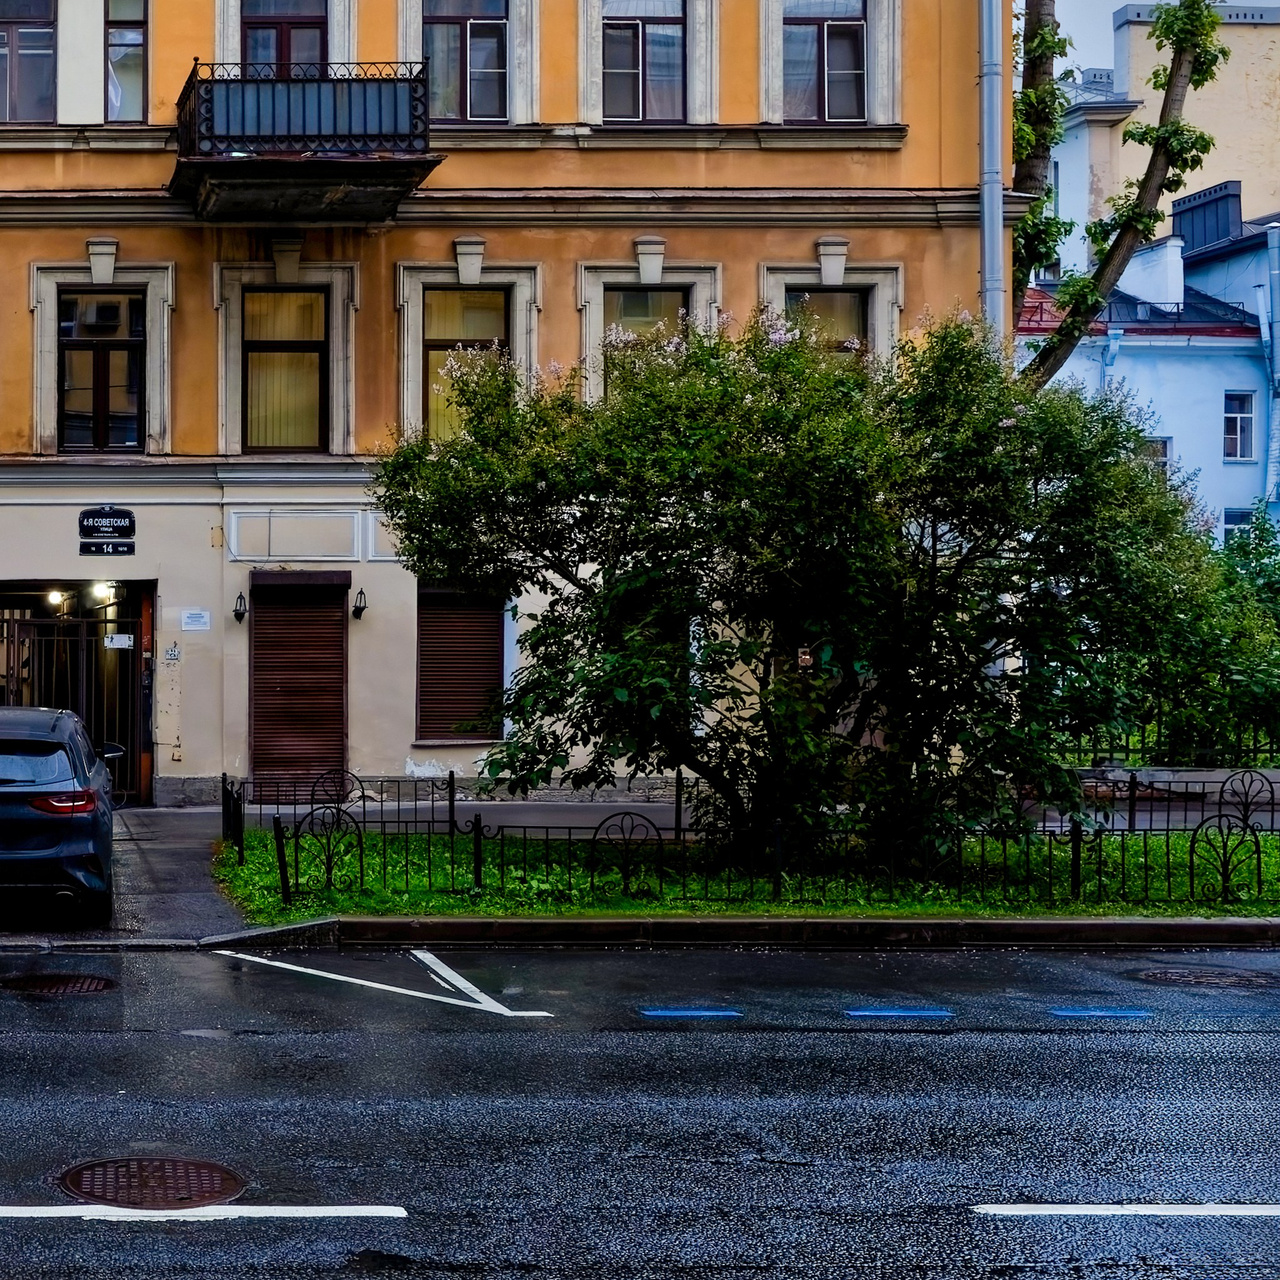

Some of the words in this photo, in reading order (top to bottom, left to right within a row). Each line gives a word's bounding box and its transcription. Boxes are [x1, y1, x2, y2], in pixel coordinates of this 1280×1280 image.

[83, 518, 93, 526] 4-Я
[94, 518, 129, 526] СОВЕТСКАЯ
[103, 544, 113, 553] 14
